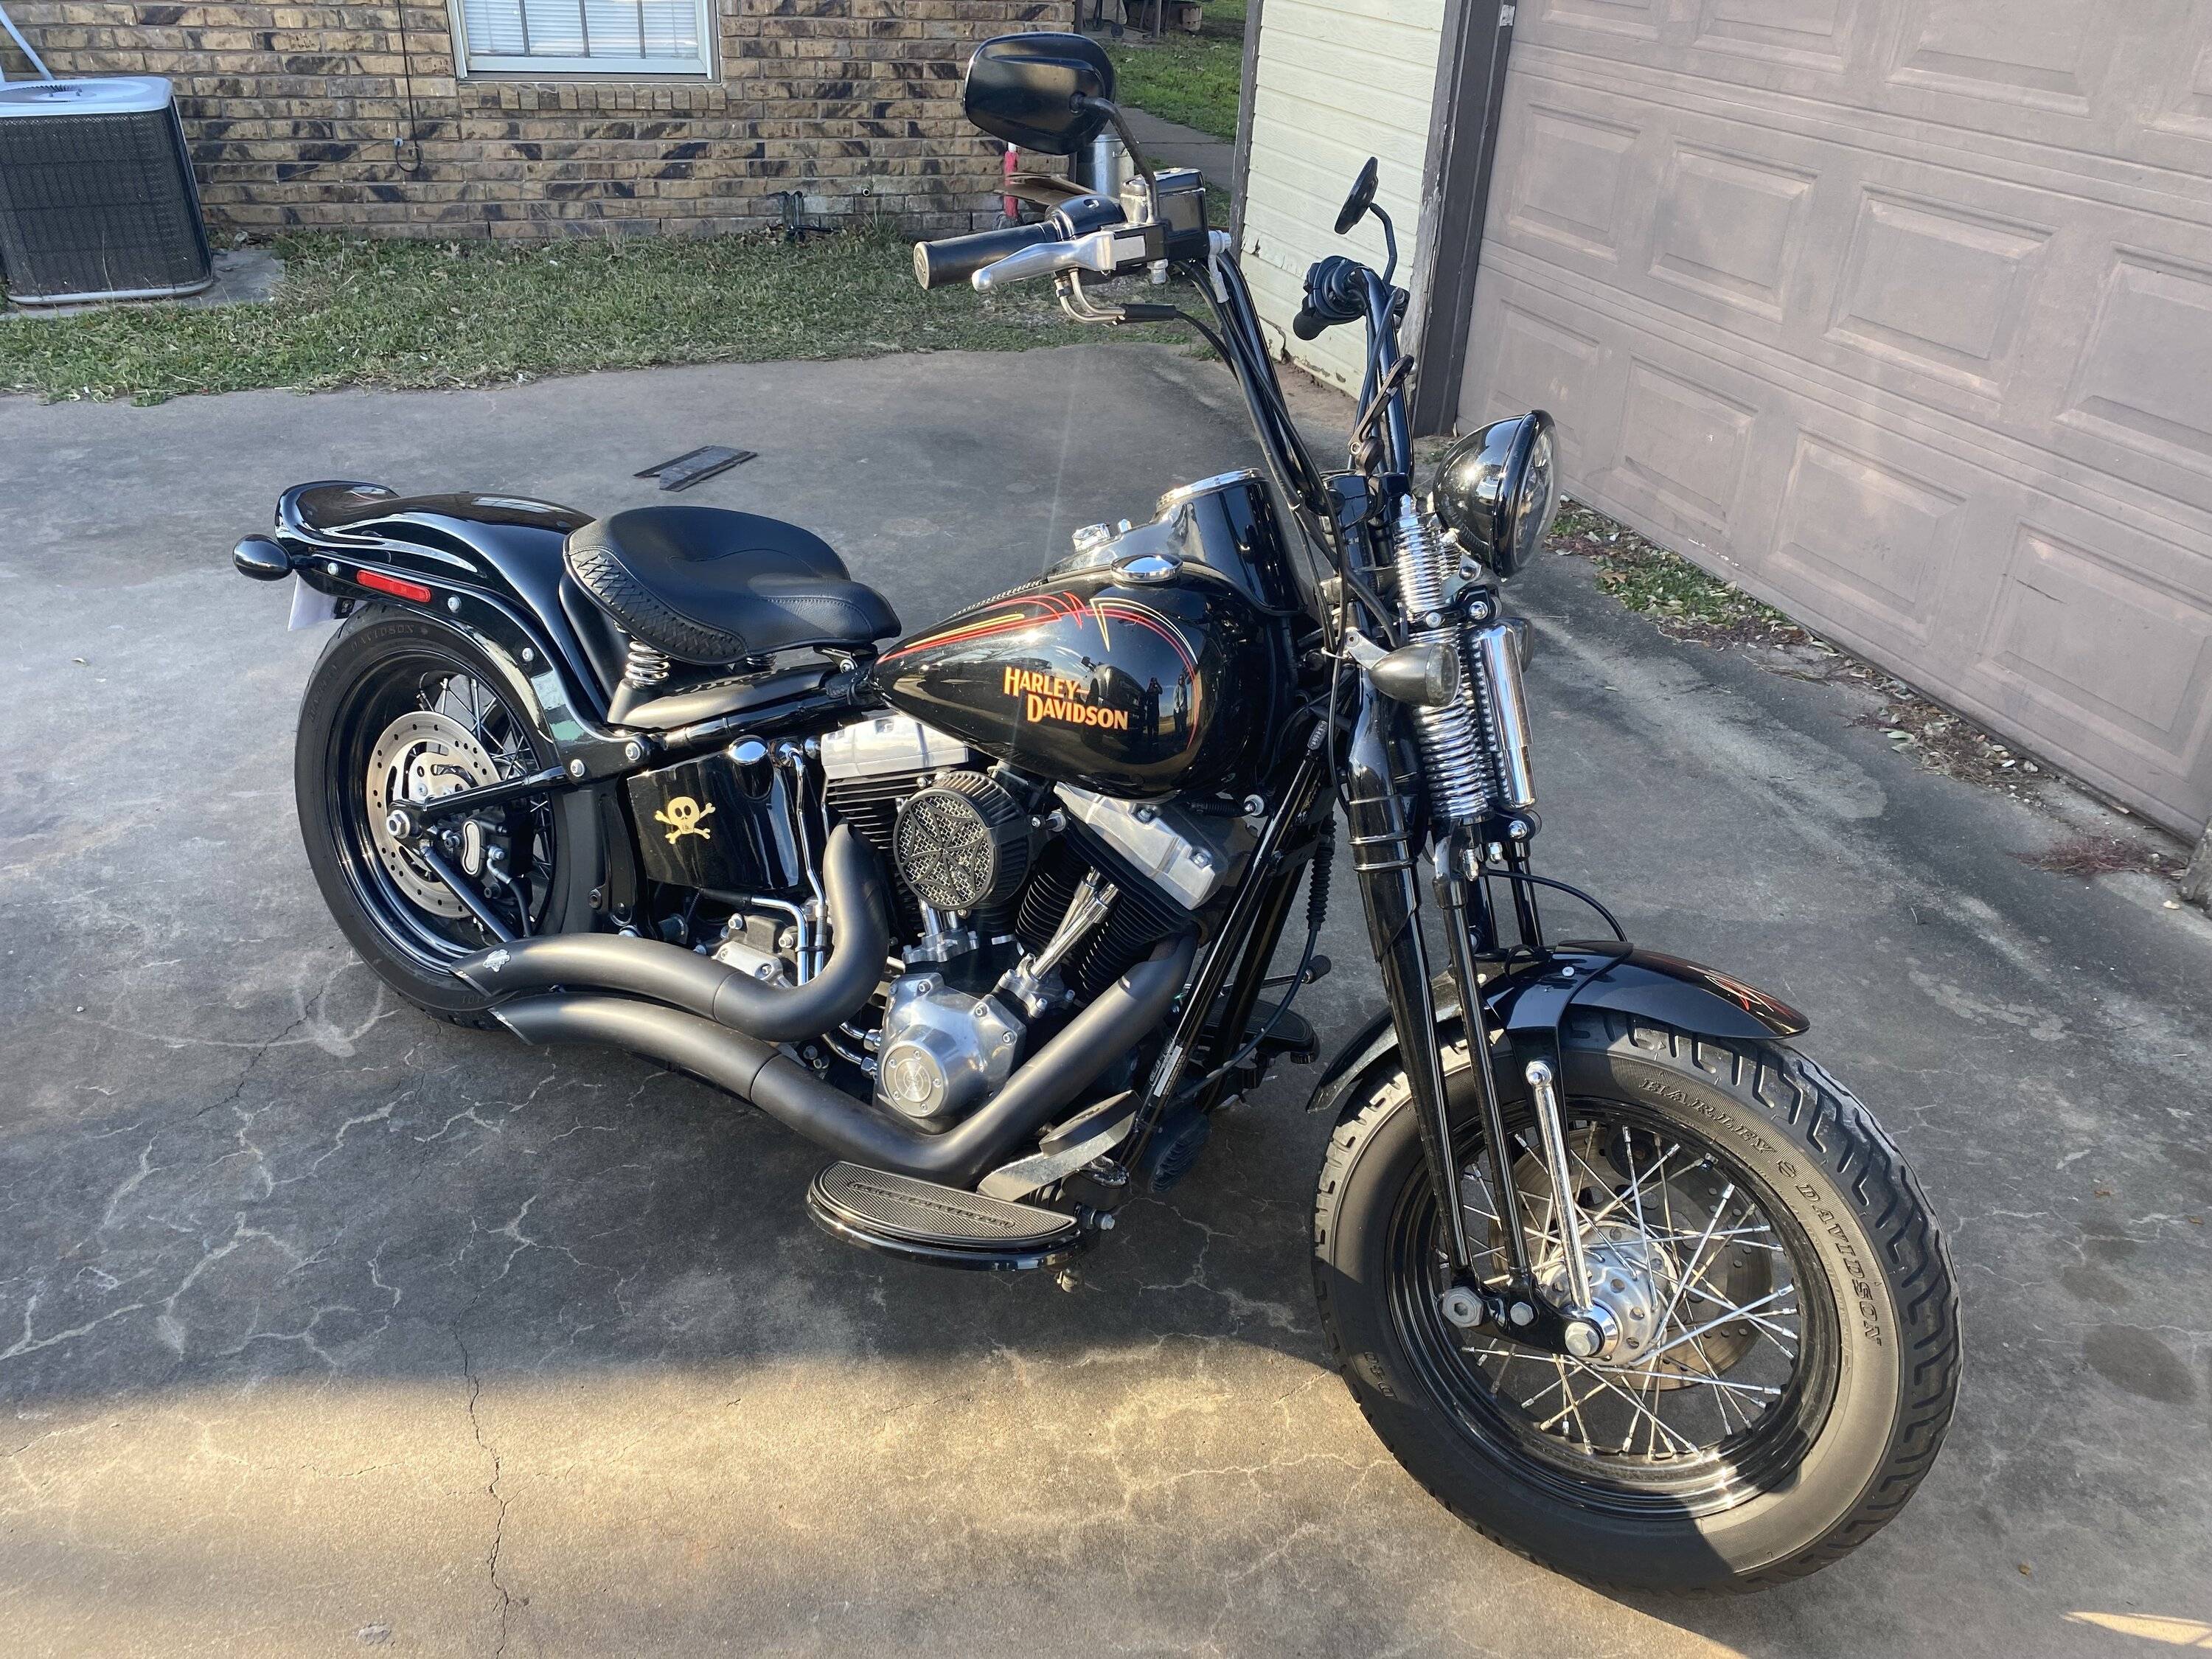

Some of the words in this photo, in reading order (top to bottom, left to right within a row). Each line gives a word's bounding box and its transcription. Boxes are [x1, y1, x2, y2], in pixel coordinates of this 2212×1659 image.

[1026, 693, 1129, 730] DAVIDSON
[1638, 1078, 1777, 1155] HARLEY
[1795, 1184, 1882, 1346] DAVIDSON
